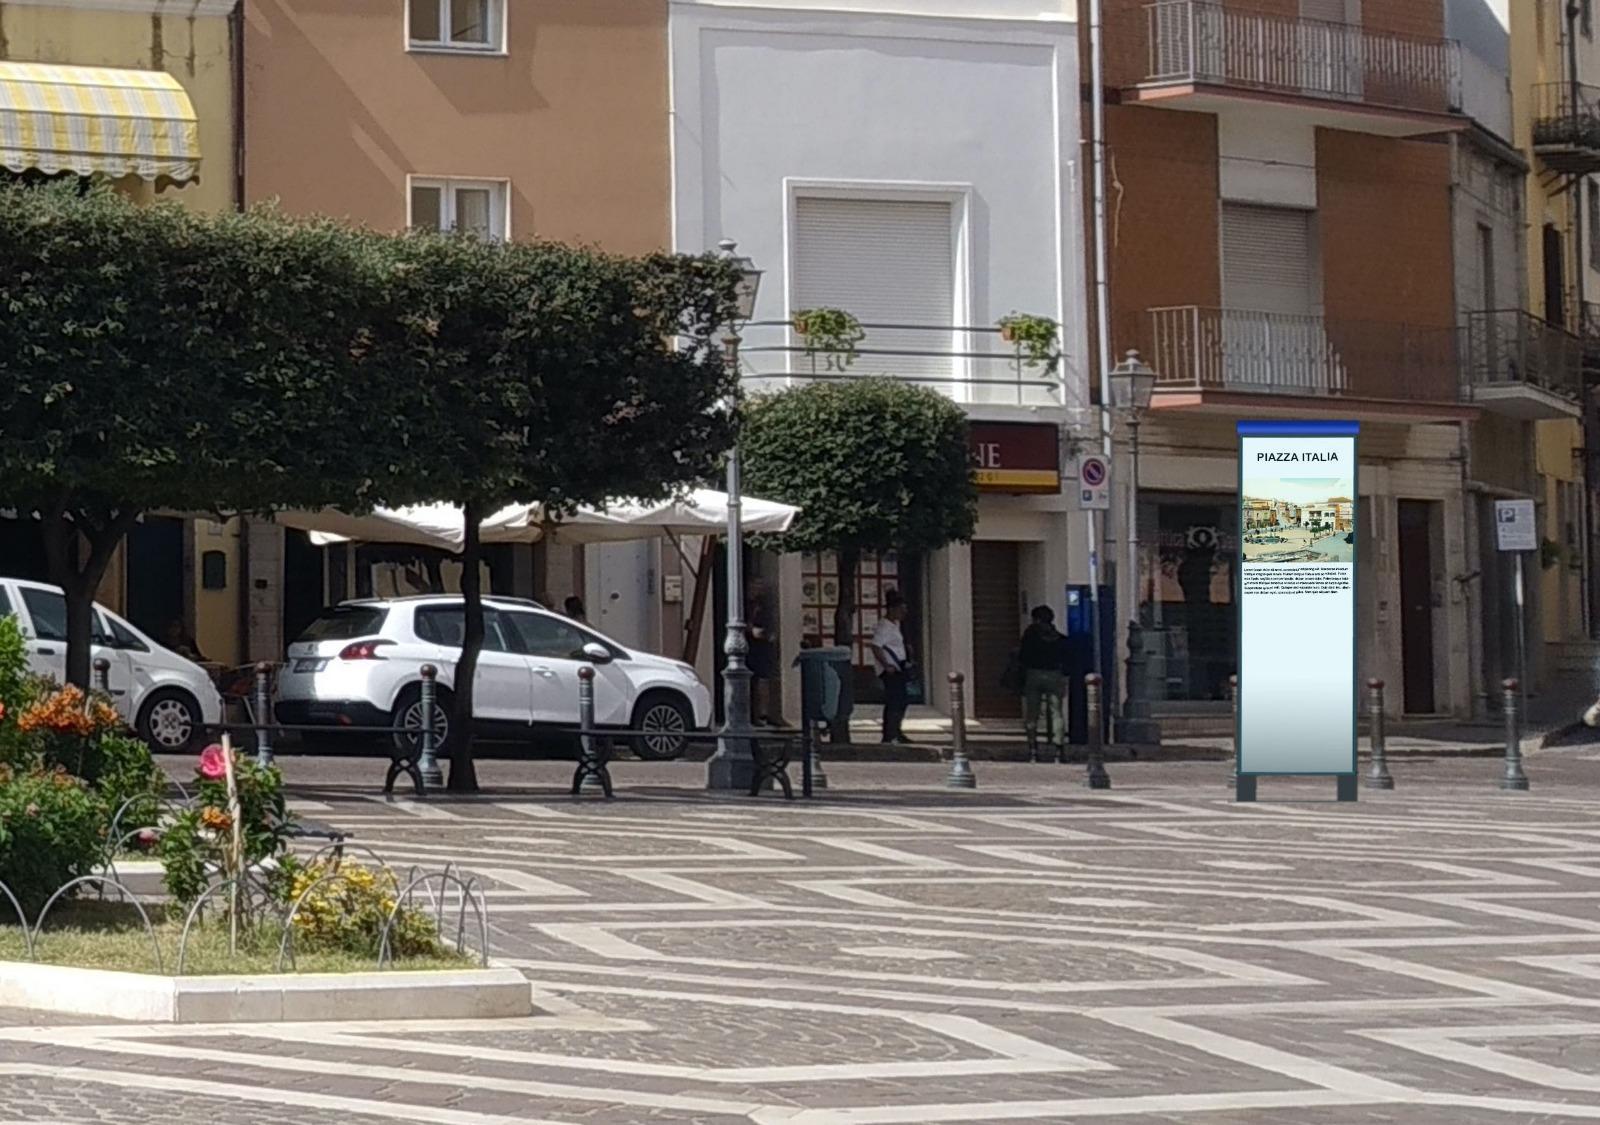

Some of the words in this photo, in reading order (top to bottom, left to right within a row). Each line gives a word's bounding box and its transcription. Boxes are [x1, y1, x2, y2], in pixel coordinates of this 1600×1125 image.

[1256, 452, 1299, 462] PIAZZA
[1302, 452, 1339, 462] ITALIA
[1501, 509, 1513, 522] P
